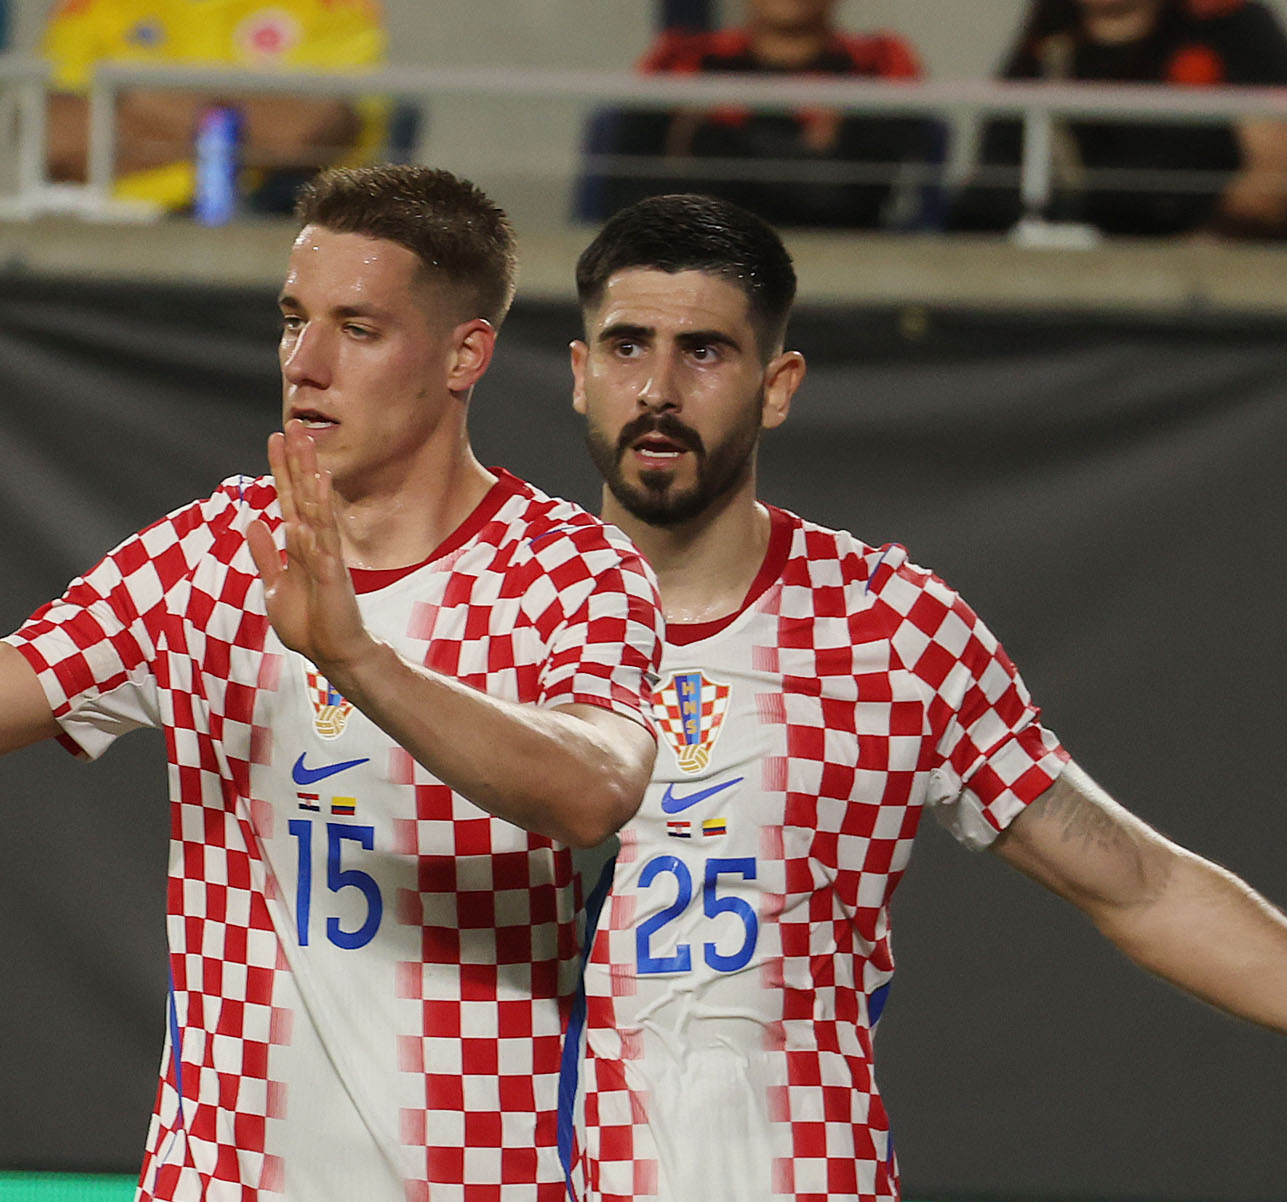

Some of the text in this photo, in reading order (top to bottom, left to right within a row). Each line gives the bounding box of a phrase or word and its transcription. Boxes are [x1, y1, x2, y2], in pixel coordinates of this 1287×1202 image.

[681, 682, 697, 734] HNS
[287, 818, 384, 950] 15
[635, 855, 759, 975] 25
